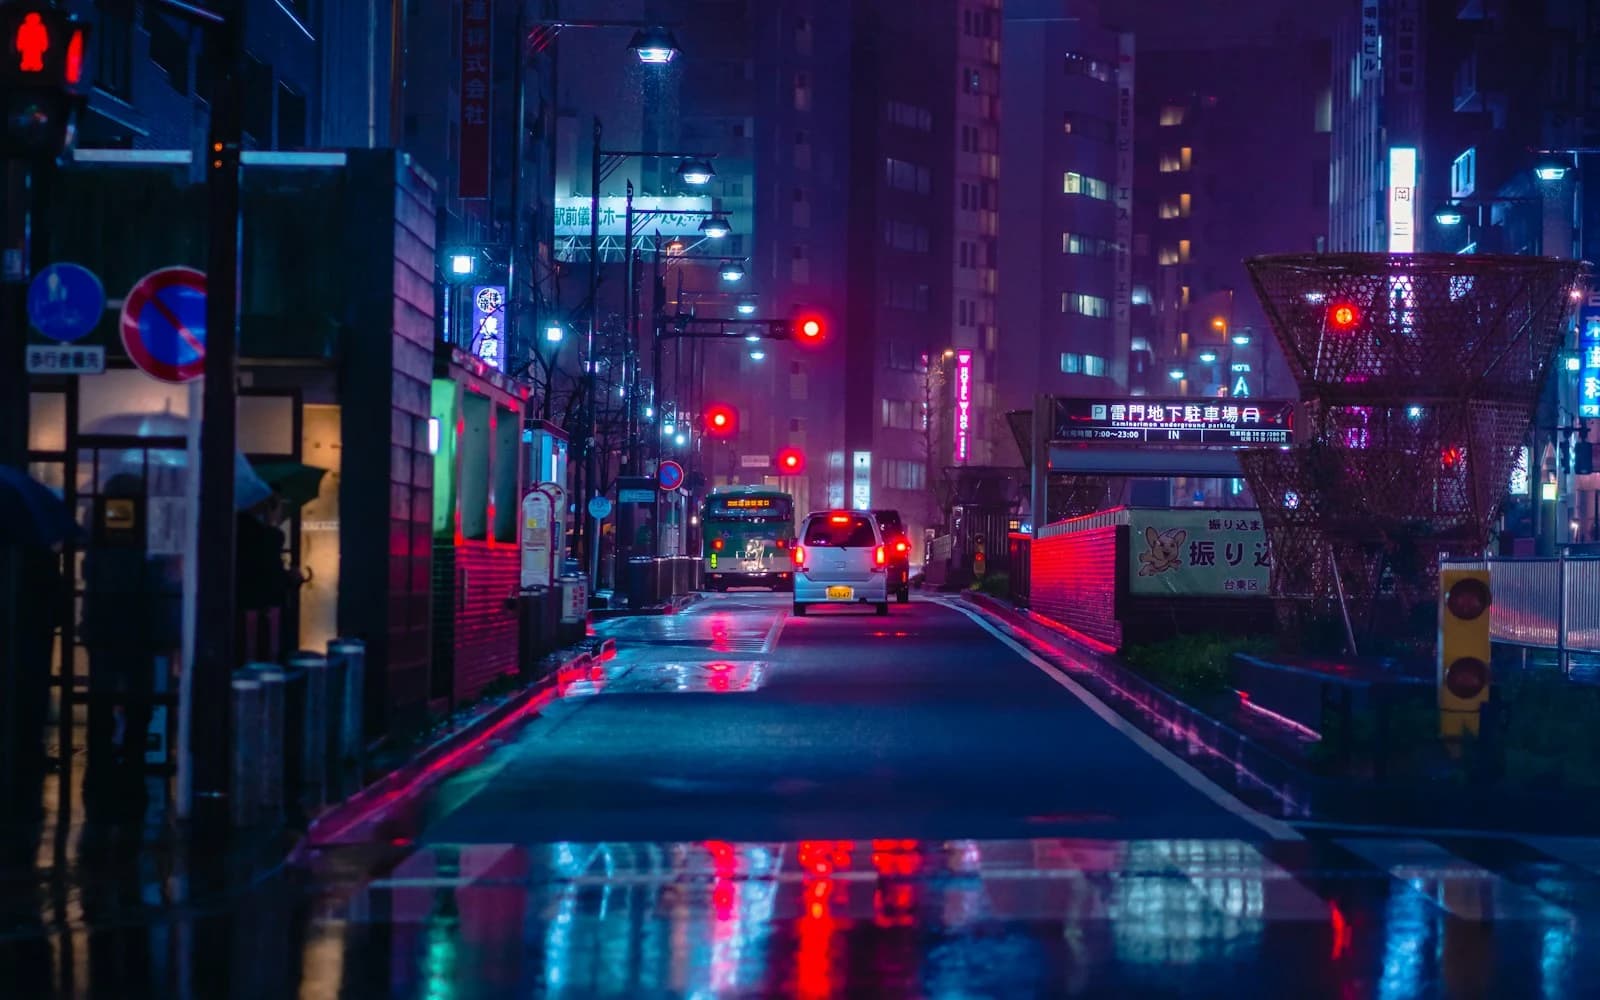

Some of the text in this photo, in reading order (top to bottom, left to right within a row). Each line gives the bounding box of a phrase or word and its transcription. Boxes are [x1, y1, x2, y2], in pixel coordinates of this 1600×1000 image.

[1110, 404, 1239, 423] 雷門地下駐車場
[1160, 421, 1205, 430] underground
[1208, 422, 1235, 430] parking
[1168, 430, 1180, 440] IN
[1208, 519, 1262, 531] 振り込ま
[1189, 540, 1271, 567] 振り込
[1223, 579, 1257, 591] 台東区
